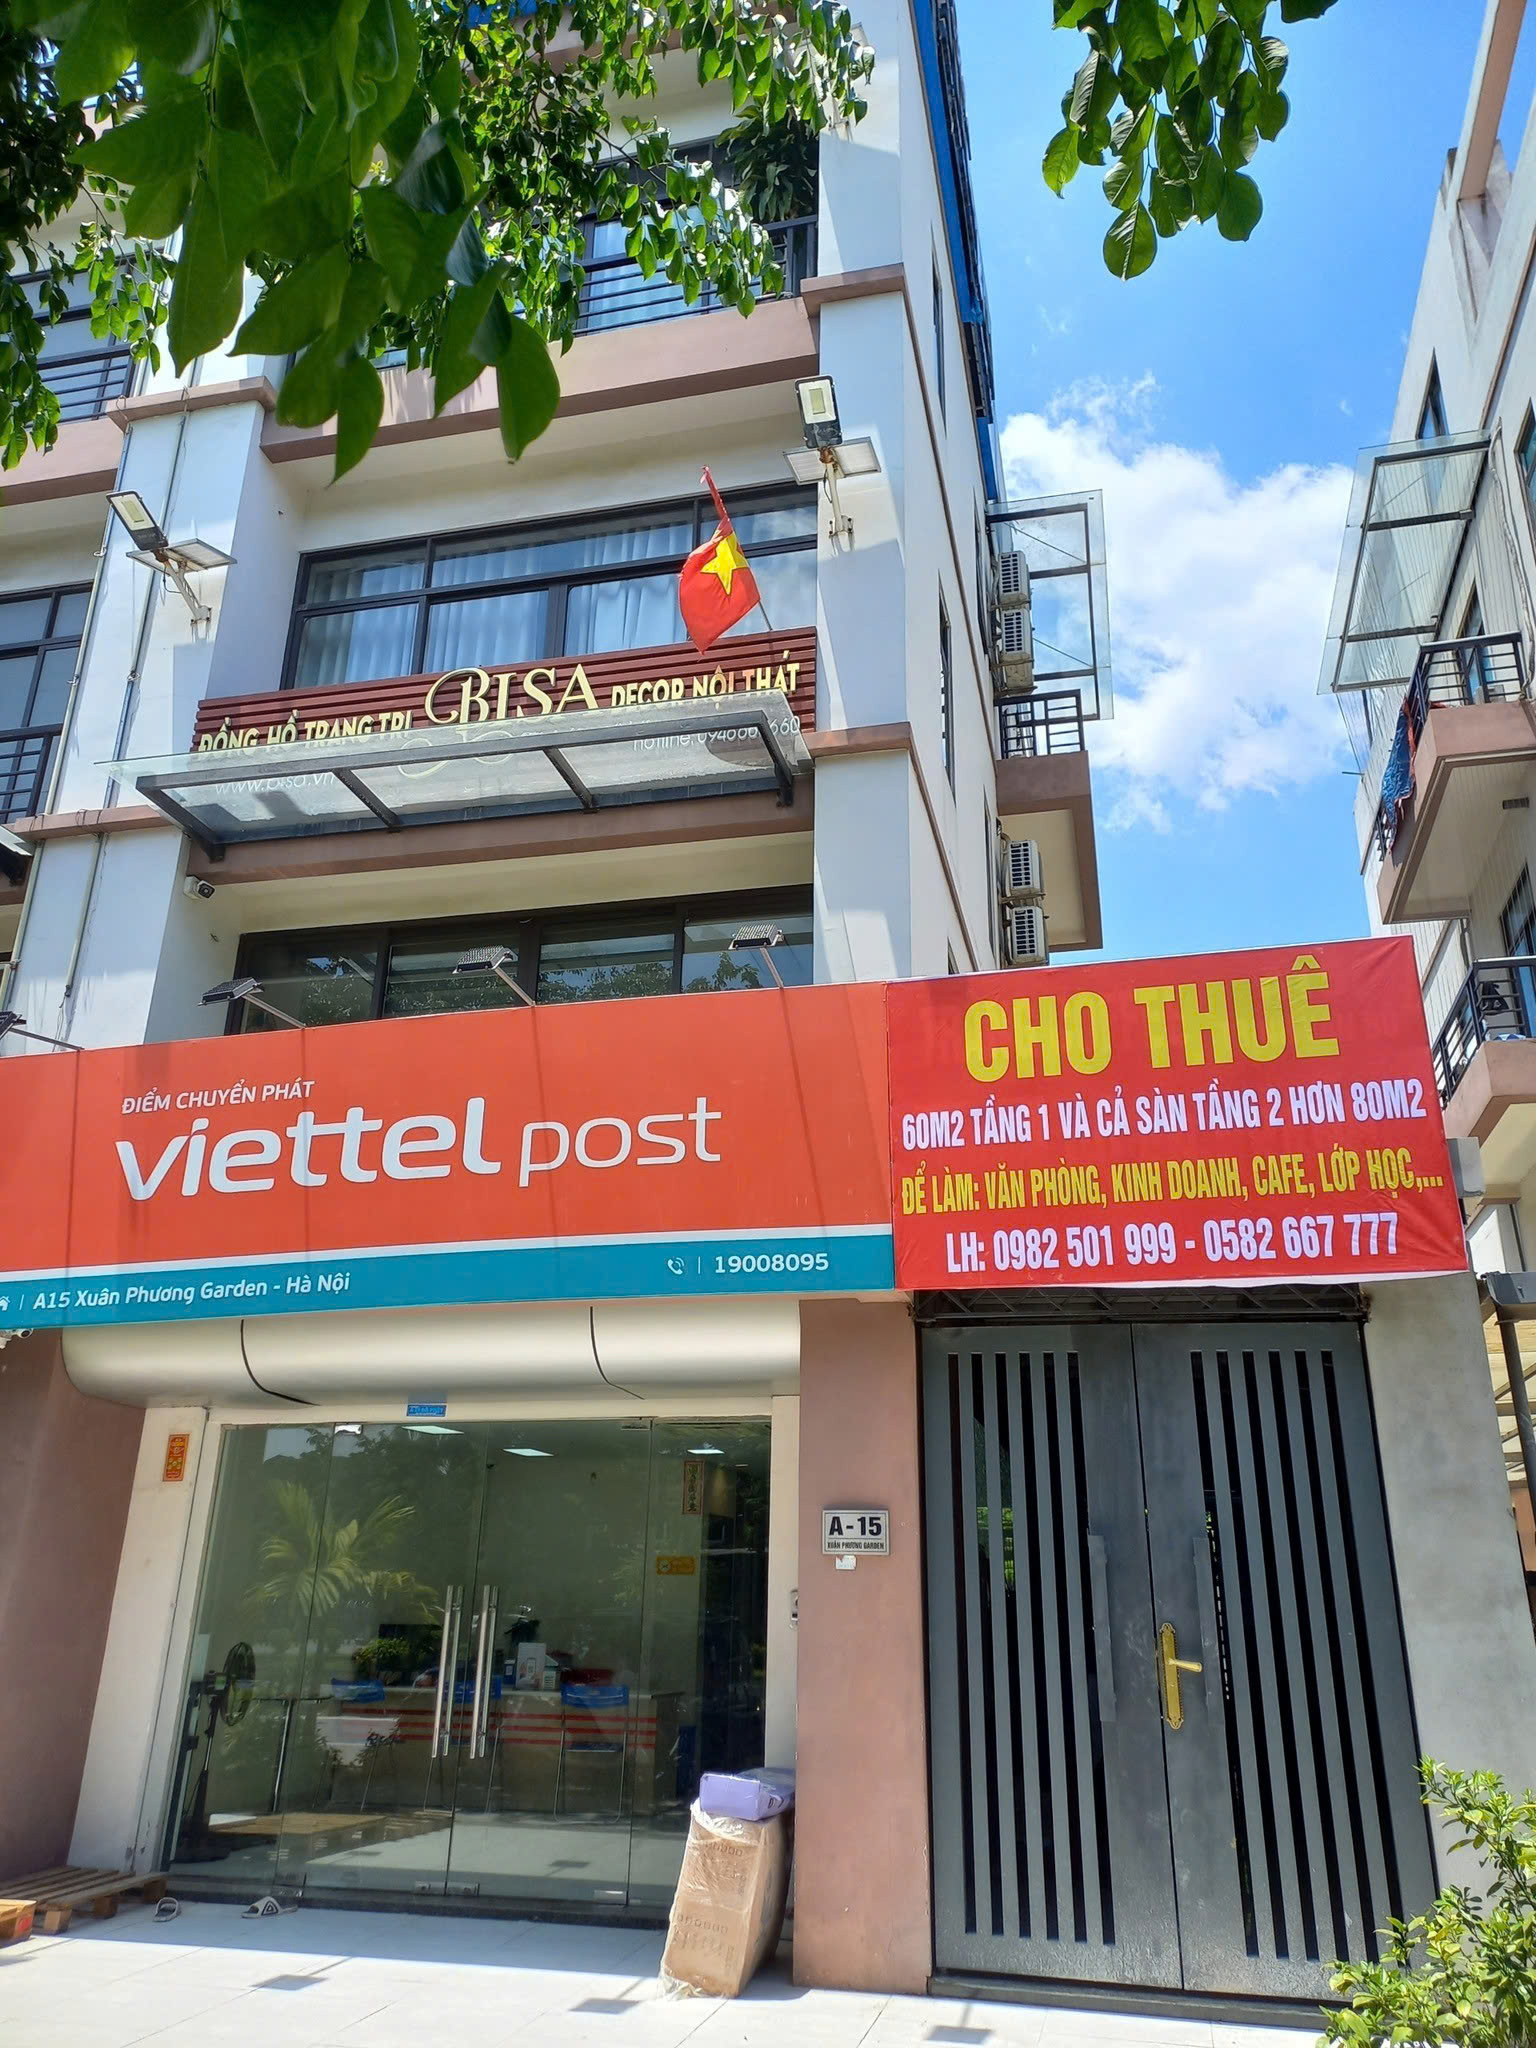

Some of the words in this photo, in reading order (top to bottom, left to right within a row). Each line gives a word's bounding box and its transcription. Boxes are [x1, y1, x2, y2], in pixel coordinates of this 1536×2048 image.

[425, 663, 599, 724] BISA
[611, 677, 684, 707] DECOR
[304, 714, 375, 741] TRANG
[964, 991, 1112, 1082] CHO
[1134, 955, 1339, 1069] THUÊ
[121, 1087, 171, 1114] ĐIỂM
[176, 1079, 256, 1109] CHUYỂN
[261, 1077, 315, 1101] PHÁT
[903, 1115, 965, 1151] 60M2
[970, 1093, 1032, 1146] TẦNG
[1038, 1108, 1050, 1141] 1
[1060, 1095, 1091, 1140] VÀ
[1096, 1086, 1129, 1138] CẢ
[1136, 1088, 1188, 1134] SÀN
[1192, 1078, 1261, 1131] TẦNG
[1267, 1088, 1285, 1127] 2
[1290, 1081, 1344, 1124] HƠN
[1352, 1078, 1428, 1120] 80M2
[115, 1097, 502, 1200] viettel
[519, 1097, 722, 1187] post
[902, 1161, 928, 1215] ĐỂ
[931, 1164, 979, 1213] LÀM:
[984, 1162, 1026, 1209] VĂN
[1030, 1160, 1107, 1209] PHÒNG,
[1112, 1161, 1163, 1203] KINH
[1167, 1156, 1248, 1202] DOANH,
[1253, 1153, 1316, 1199] CAFE,
[1320, 1142, 1361, 1193] LỚP
[715, 1252, 830, 1274] 19008095
[946, 1230, 986, 1273] LH:
[993, 1228, 1060, 1270] 0982
[1066, 1224, 1113, 1267] 501
[1125, 1222, 1177, 1265] 999
[1185, 1240, 1196, 1249] -
[1204, 1218, 1277, 1262] 0582
[1283, 1215, 1335, 1258] 667
[1344, 1212, 1398, 1255] 777
[33, 1294, 70, 1310] A15
[74, 1288, 120, 1307] Xuân
[125, 1285, 194, 1305] Phương
[200, 1280, 267, 1298] Garden
[286, 1275, 312, 1295] Hà
[317, 1271, 350, 1292] Nội
